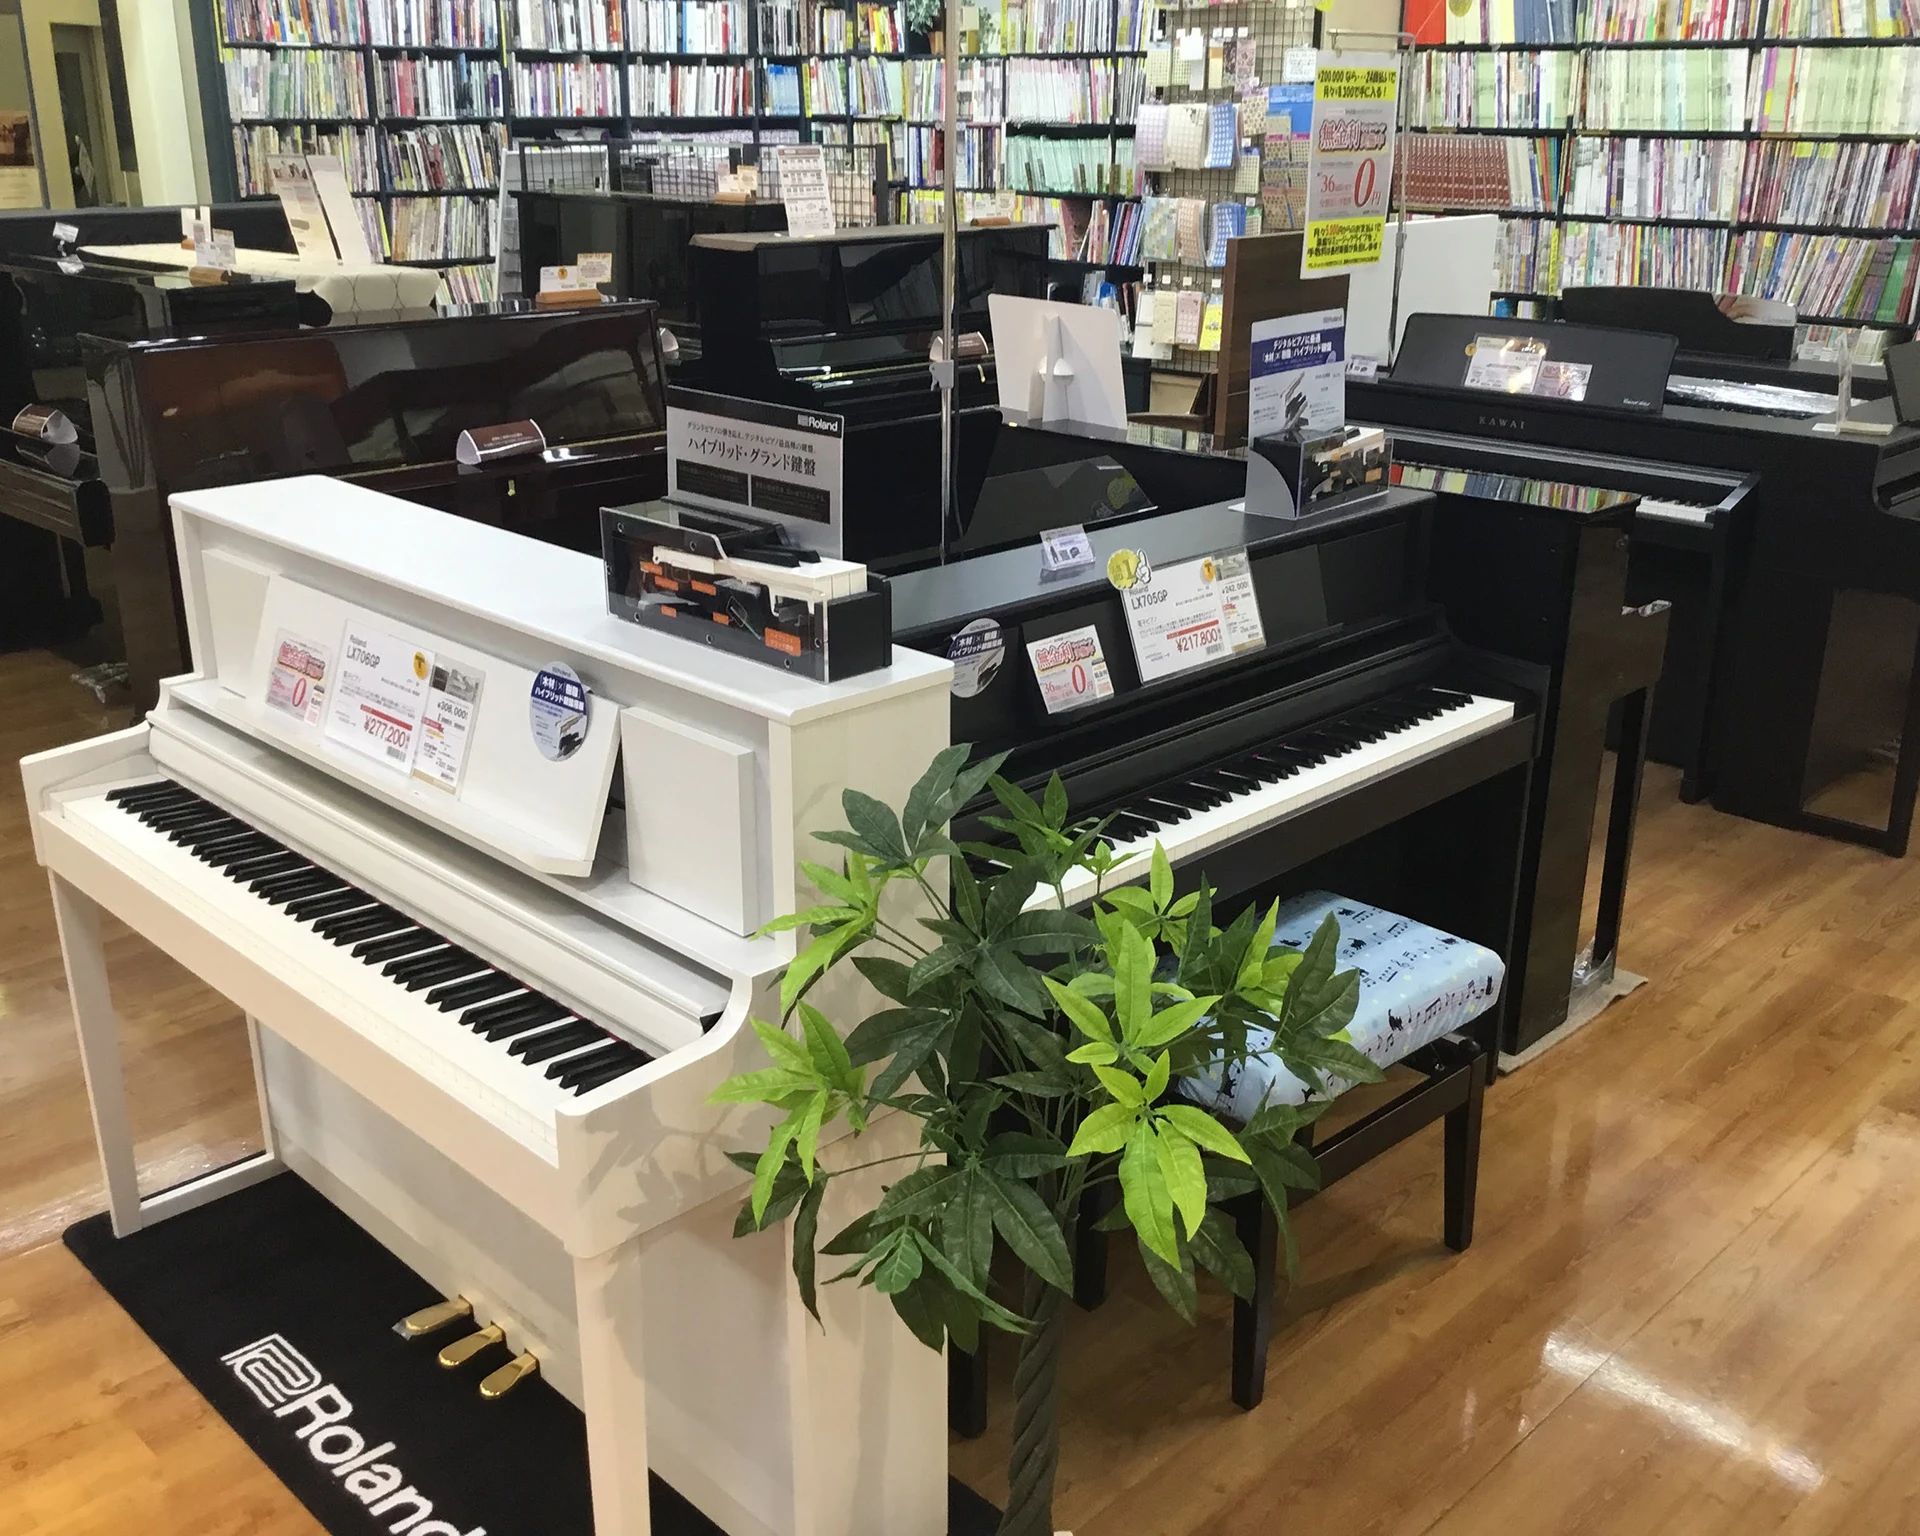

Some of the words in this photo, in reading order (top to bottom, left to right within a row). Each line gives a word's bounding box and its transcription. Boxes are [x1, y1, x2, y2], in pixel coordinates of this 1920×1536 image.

[808, 417, 839, 432] Roland
[1478, 415, 1526, 430] KAWAI
[1131, 589, 1169, 611] LX705GP
[346, 647, 381, 670] LX706GP
[273, 1383, 487, 1536] Rolan
